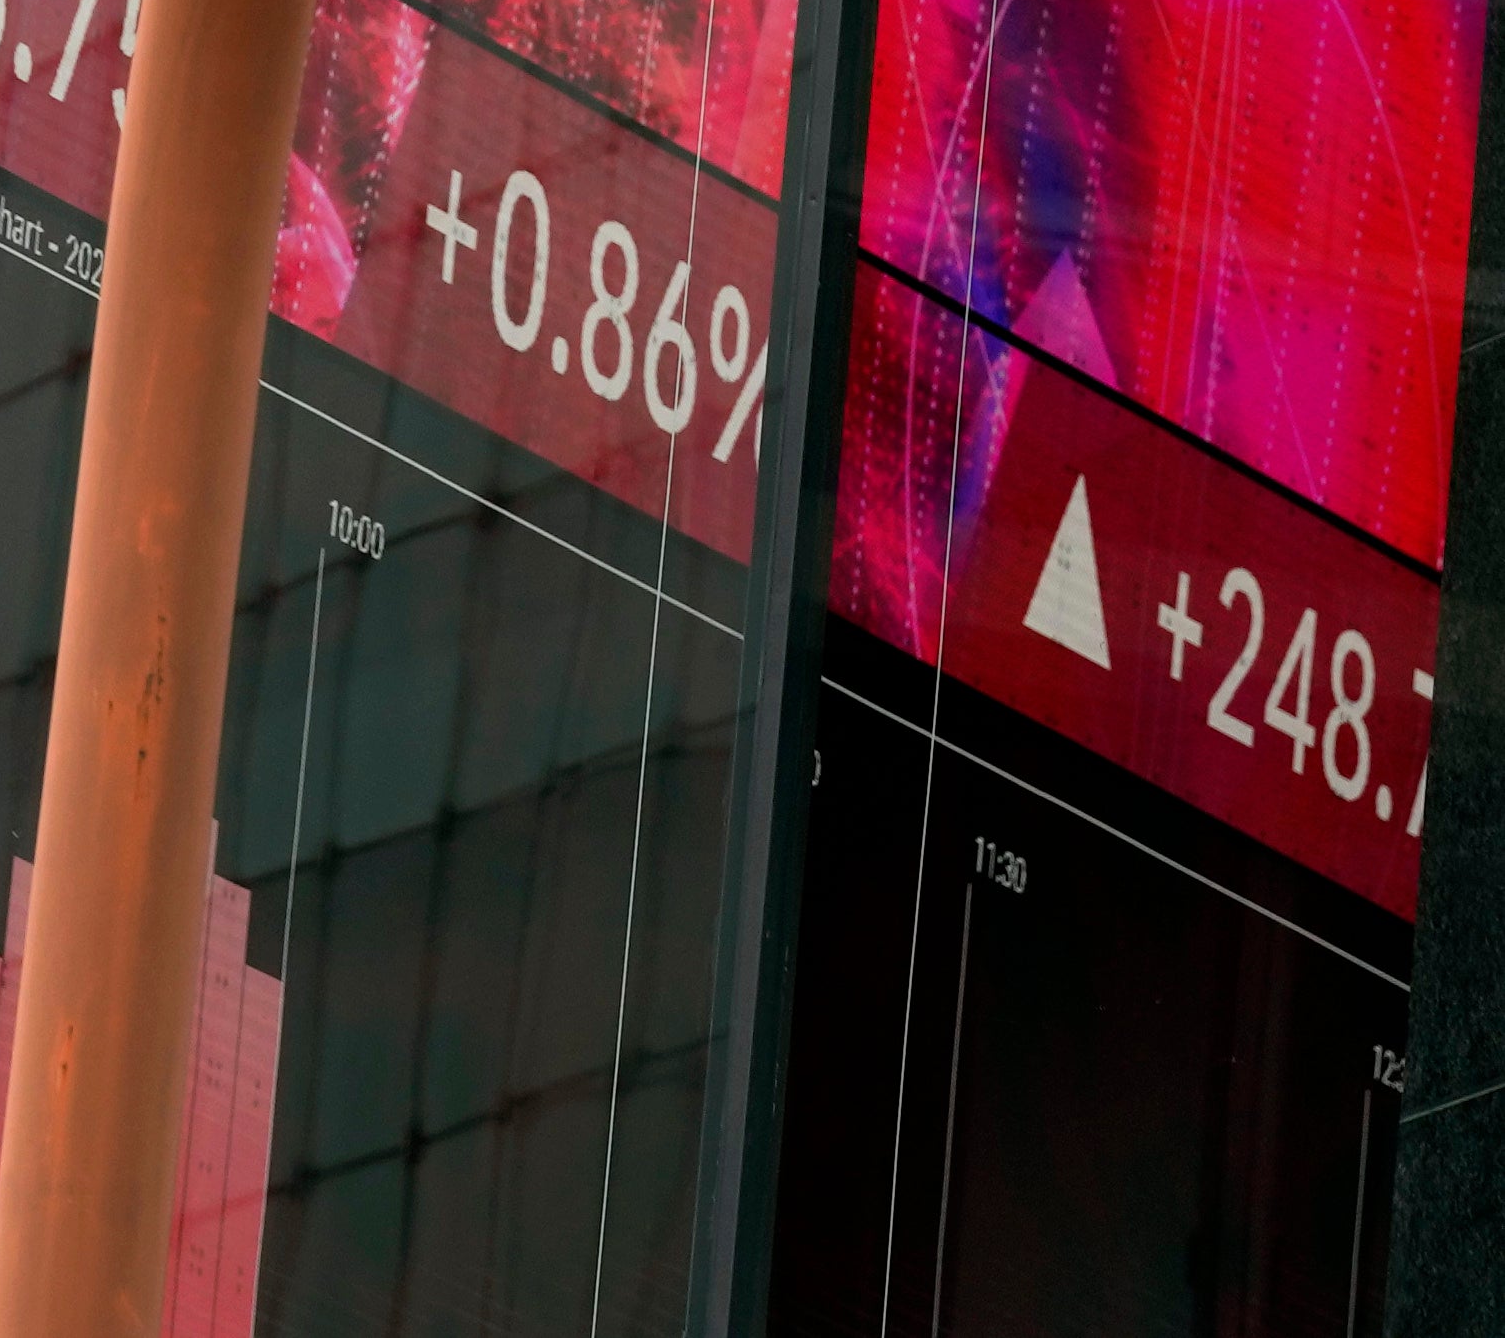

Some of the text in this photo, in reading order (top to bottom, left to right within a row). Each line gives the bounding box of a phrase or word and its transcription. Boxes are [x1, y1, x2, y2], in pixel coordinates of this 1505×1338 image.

[426, 168, 770, 472] +0.86%
[328, 499, 385, 560] 10:00
[974, 835, 1028, 894] 11:30
